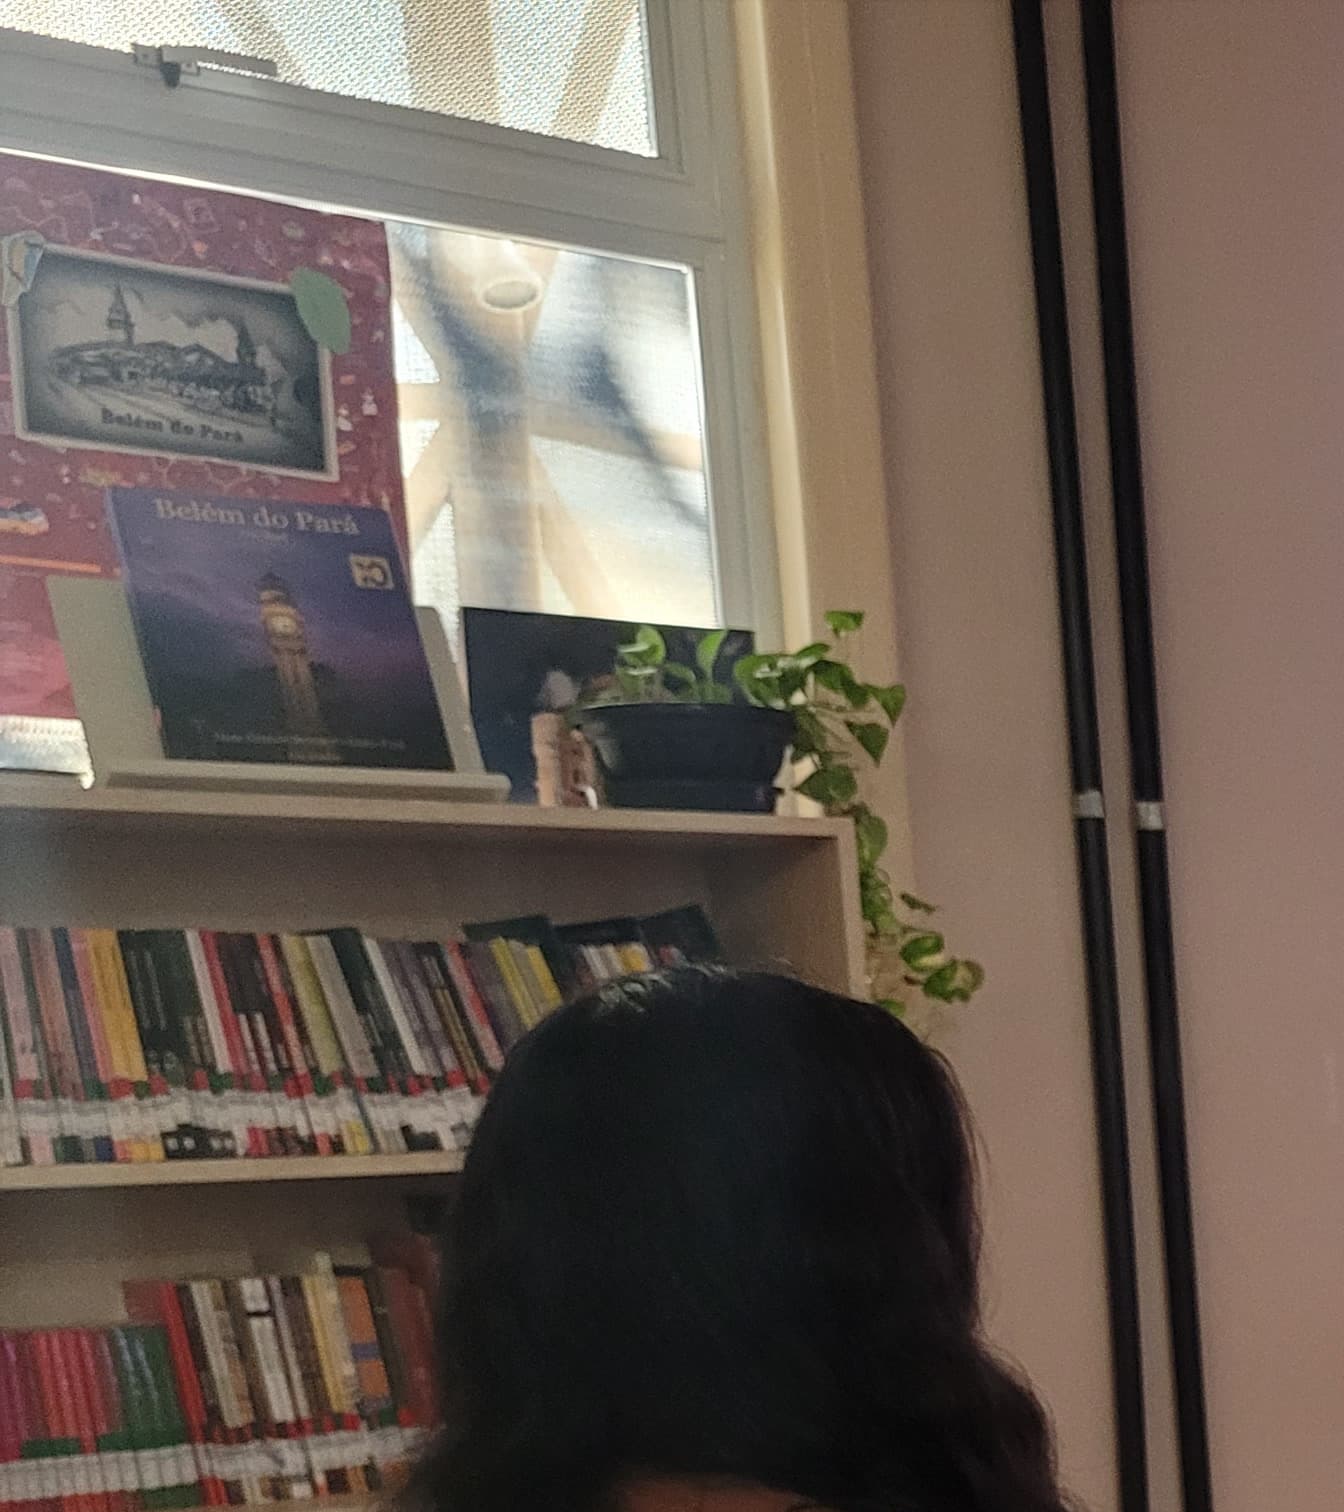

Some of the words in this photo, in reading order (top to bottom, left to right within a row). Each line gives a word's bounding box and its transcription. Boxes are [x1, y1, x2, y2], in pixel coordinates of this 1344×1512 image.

[154, 497, 246, 526] Belém
[252, 504, 289, 530] do
[294, 510, 361, 537] Pará
